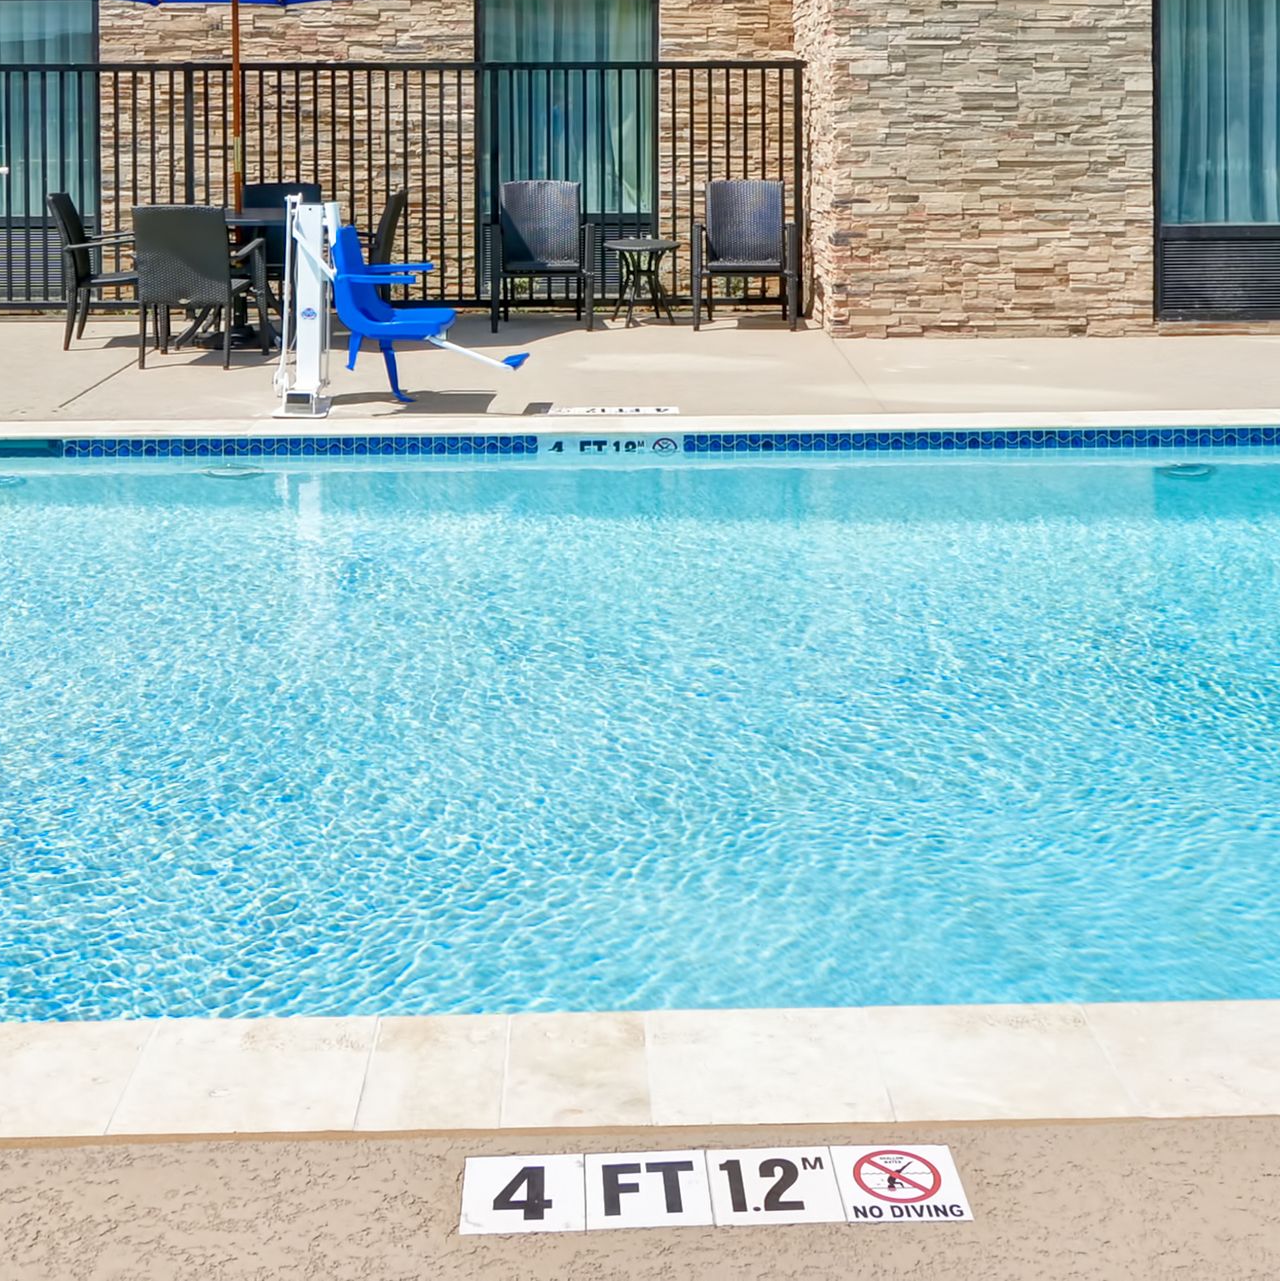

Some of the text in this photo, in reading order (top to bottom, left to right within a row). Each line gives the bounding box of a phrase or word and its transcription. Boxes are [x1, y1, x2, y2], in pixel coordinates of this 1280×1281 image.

[493, 1166, 552, 1220] 4
[602, 1161, 694, 1216] FT
[853, 1204, 964, 1219] NO DIVING
